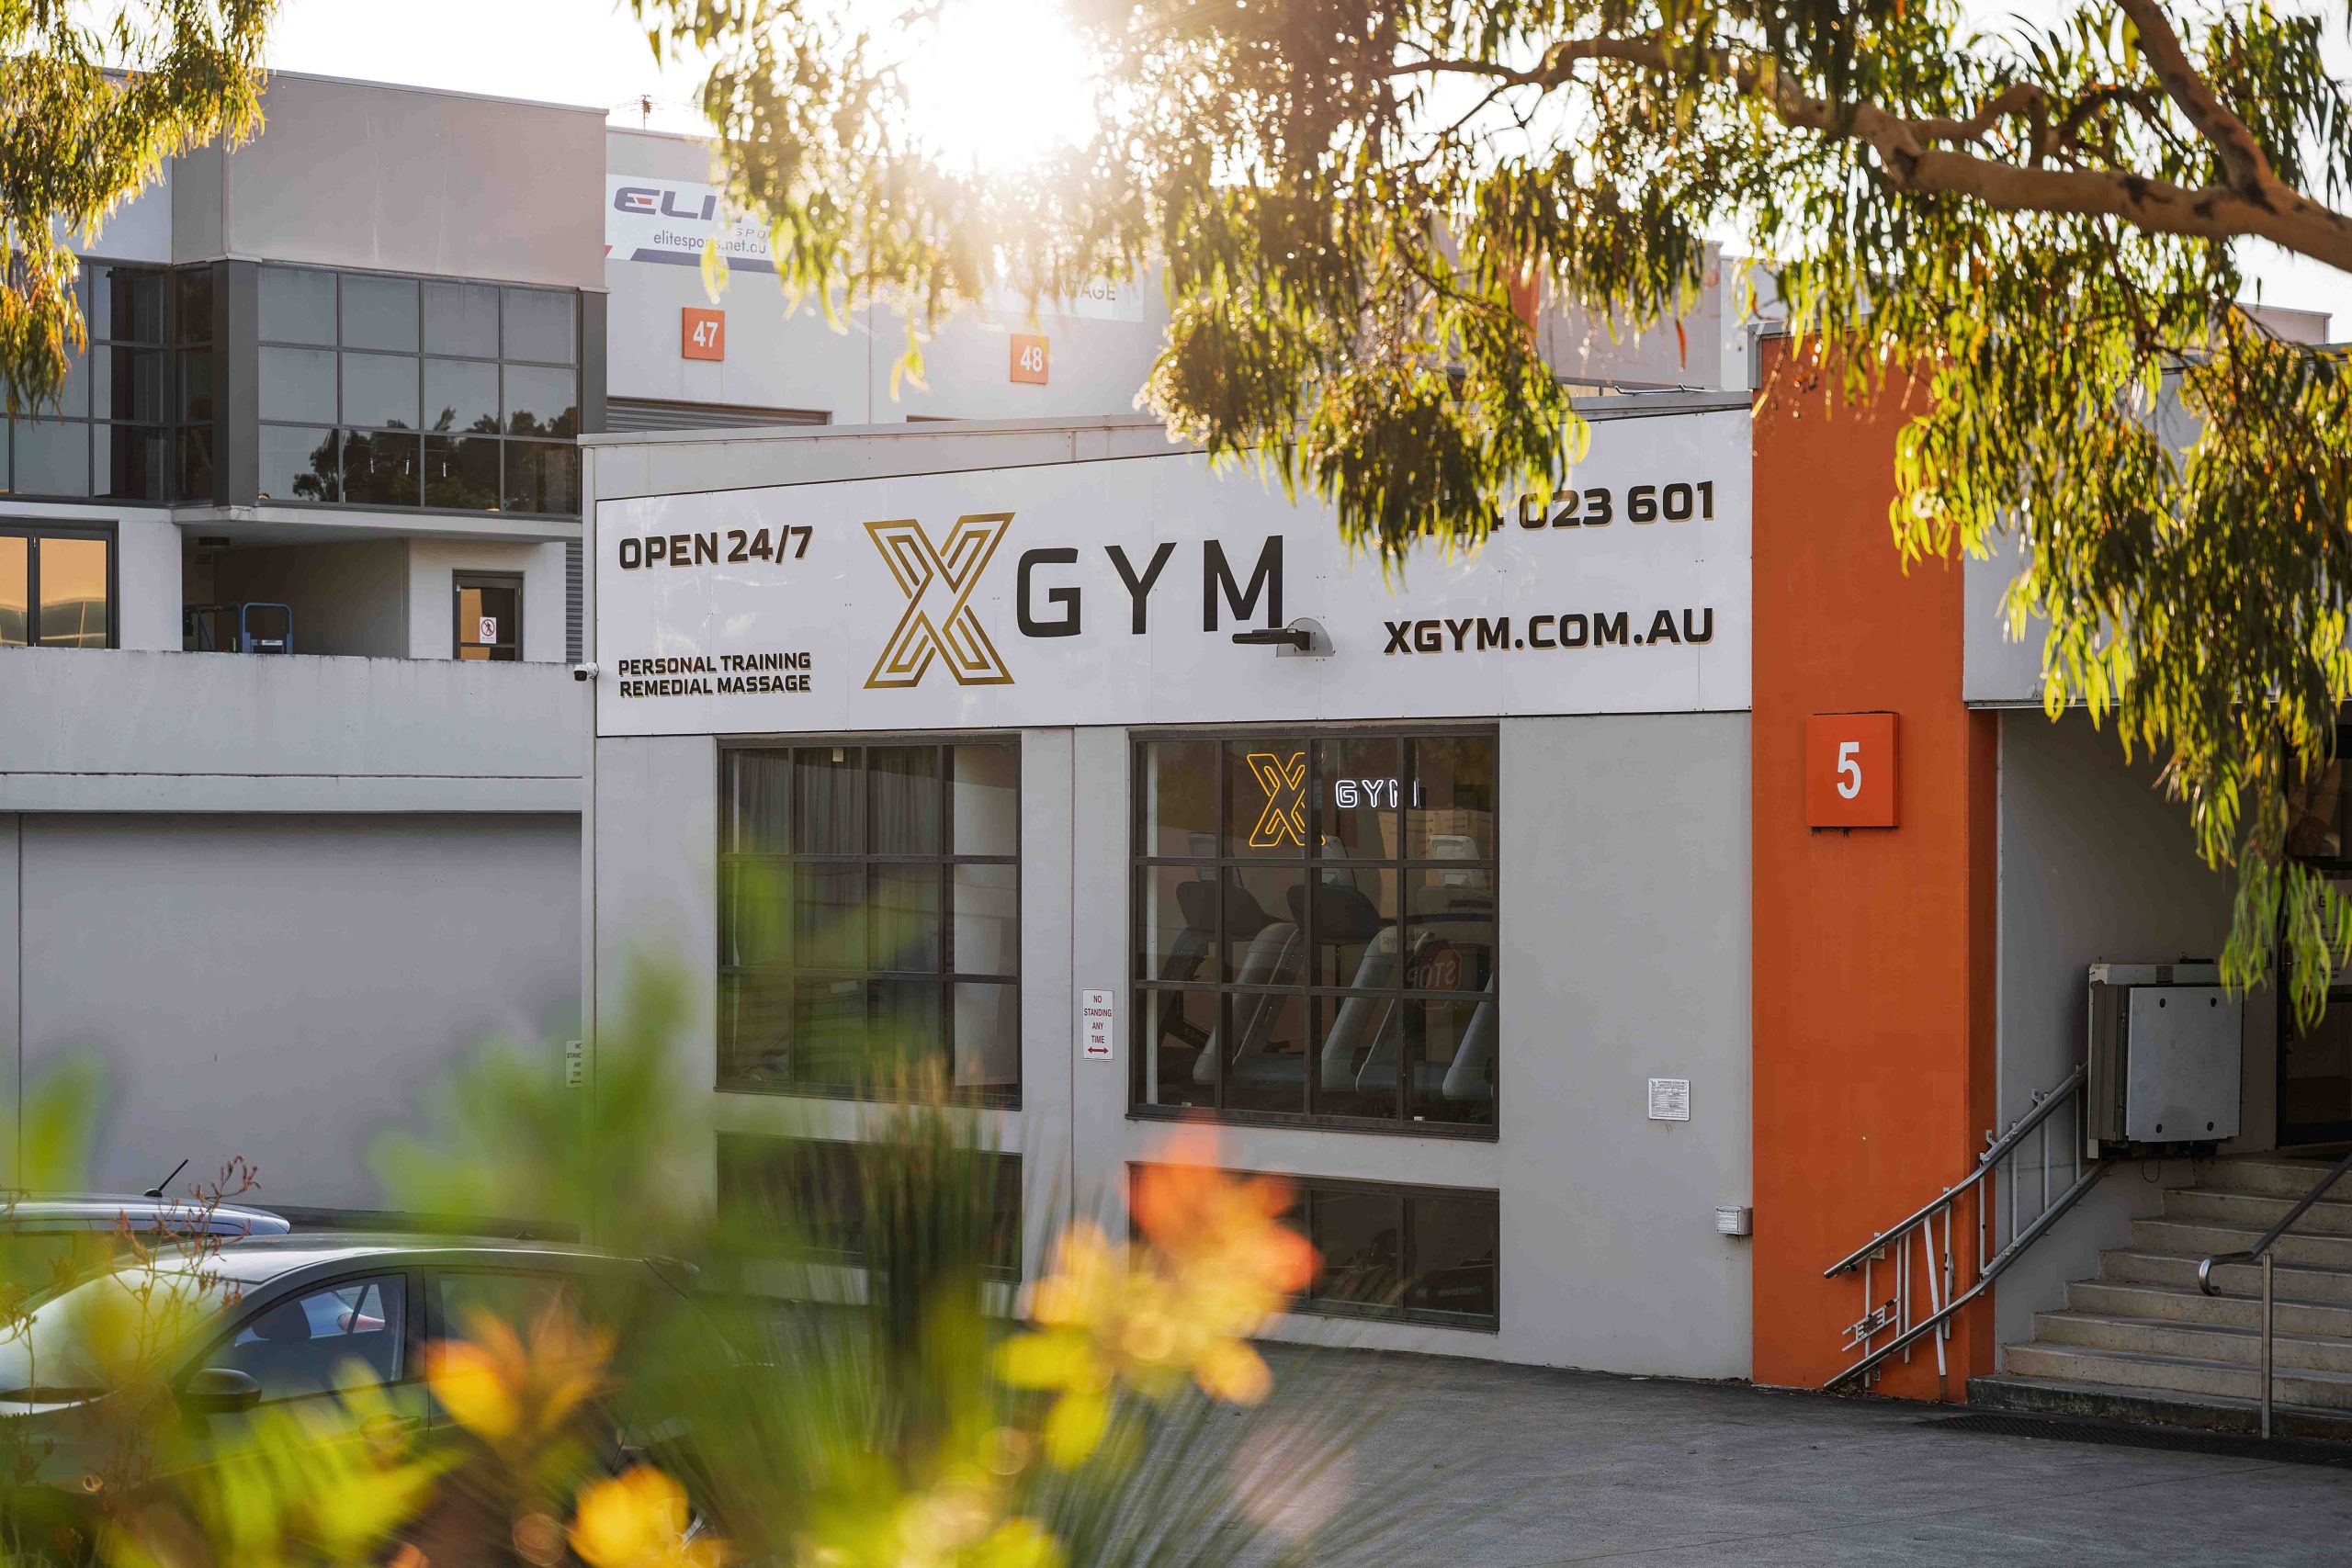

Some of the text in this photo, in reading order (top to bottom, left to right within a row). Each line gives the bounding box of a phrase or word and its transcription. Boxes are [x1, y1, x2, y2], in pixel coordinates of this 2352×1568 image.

[614, 186, 776, 228] ELI
[653, 229, 766, 254] elitespos.net.au
[693, 320, 719, 348] 47
[1020, 345, 1043, 372] 48
[1627, 480, 1714, 523] 601
[618, 525, 814, 570] OPEN 24/7
[1384, 607, 1714, 655] XGYM.COM.AU
[618, 652, 811, 676] PERSONAL TRAINING
[619, 674, 811, 698] REMEDIAL MASSAGE
[1837, 741, 1861, 799] 5
[1093, 995, 1102, 1003] NO
[1084, 1008, 1112, 1017] STANDING
[1091, 1035, 1104, 1043] TIME
[1092, 1021, 1104, 1031] ANY
